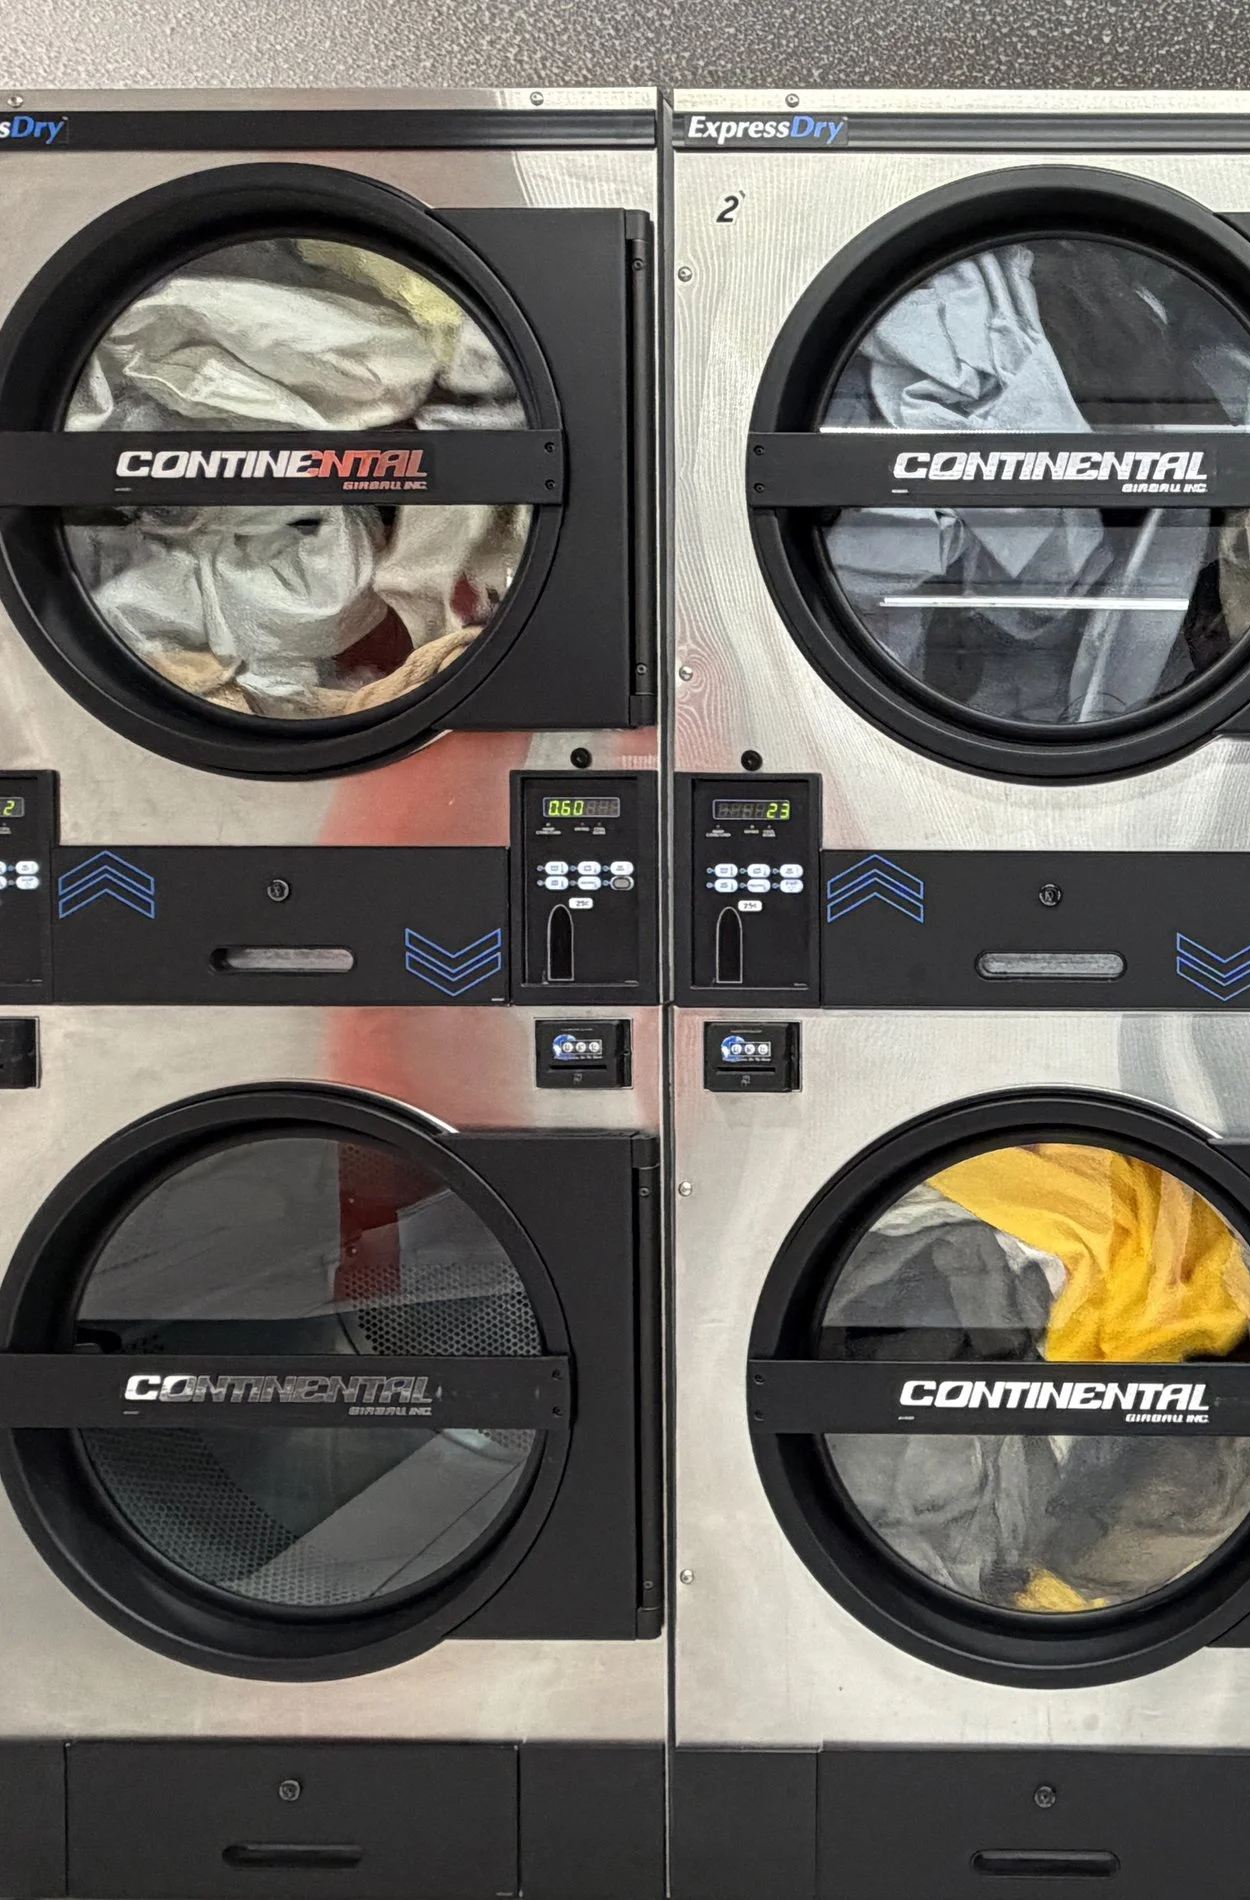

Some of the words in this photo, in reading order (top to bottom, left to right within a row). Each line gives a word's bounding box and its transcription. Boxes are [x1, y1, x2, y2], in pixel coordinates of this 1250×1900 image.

[688, 115, 844, 145] ExpressDry
[716, 195, 739, 223] 2
[116, 450, 427, 479] CONTINENTAL
[893, 452, 1207, 481] CONTINENTAL
[3, 800, 16, 815] 2
[766, 803, 790, 819] 23
[124, 1376, 432, 1404] CONTINENTAL
[900, 1380, 1209, 1411] CONTINENTAL
